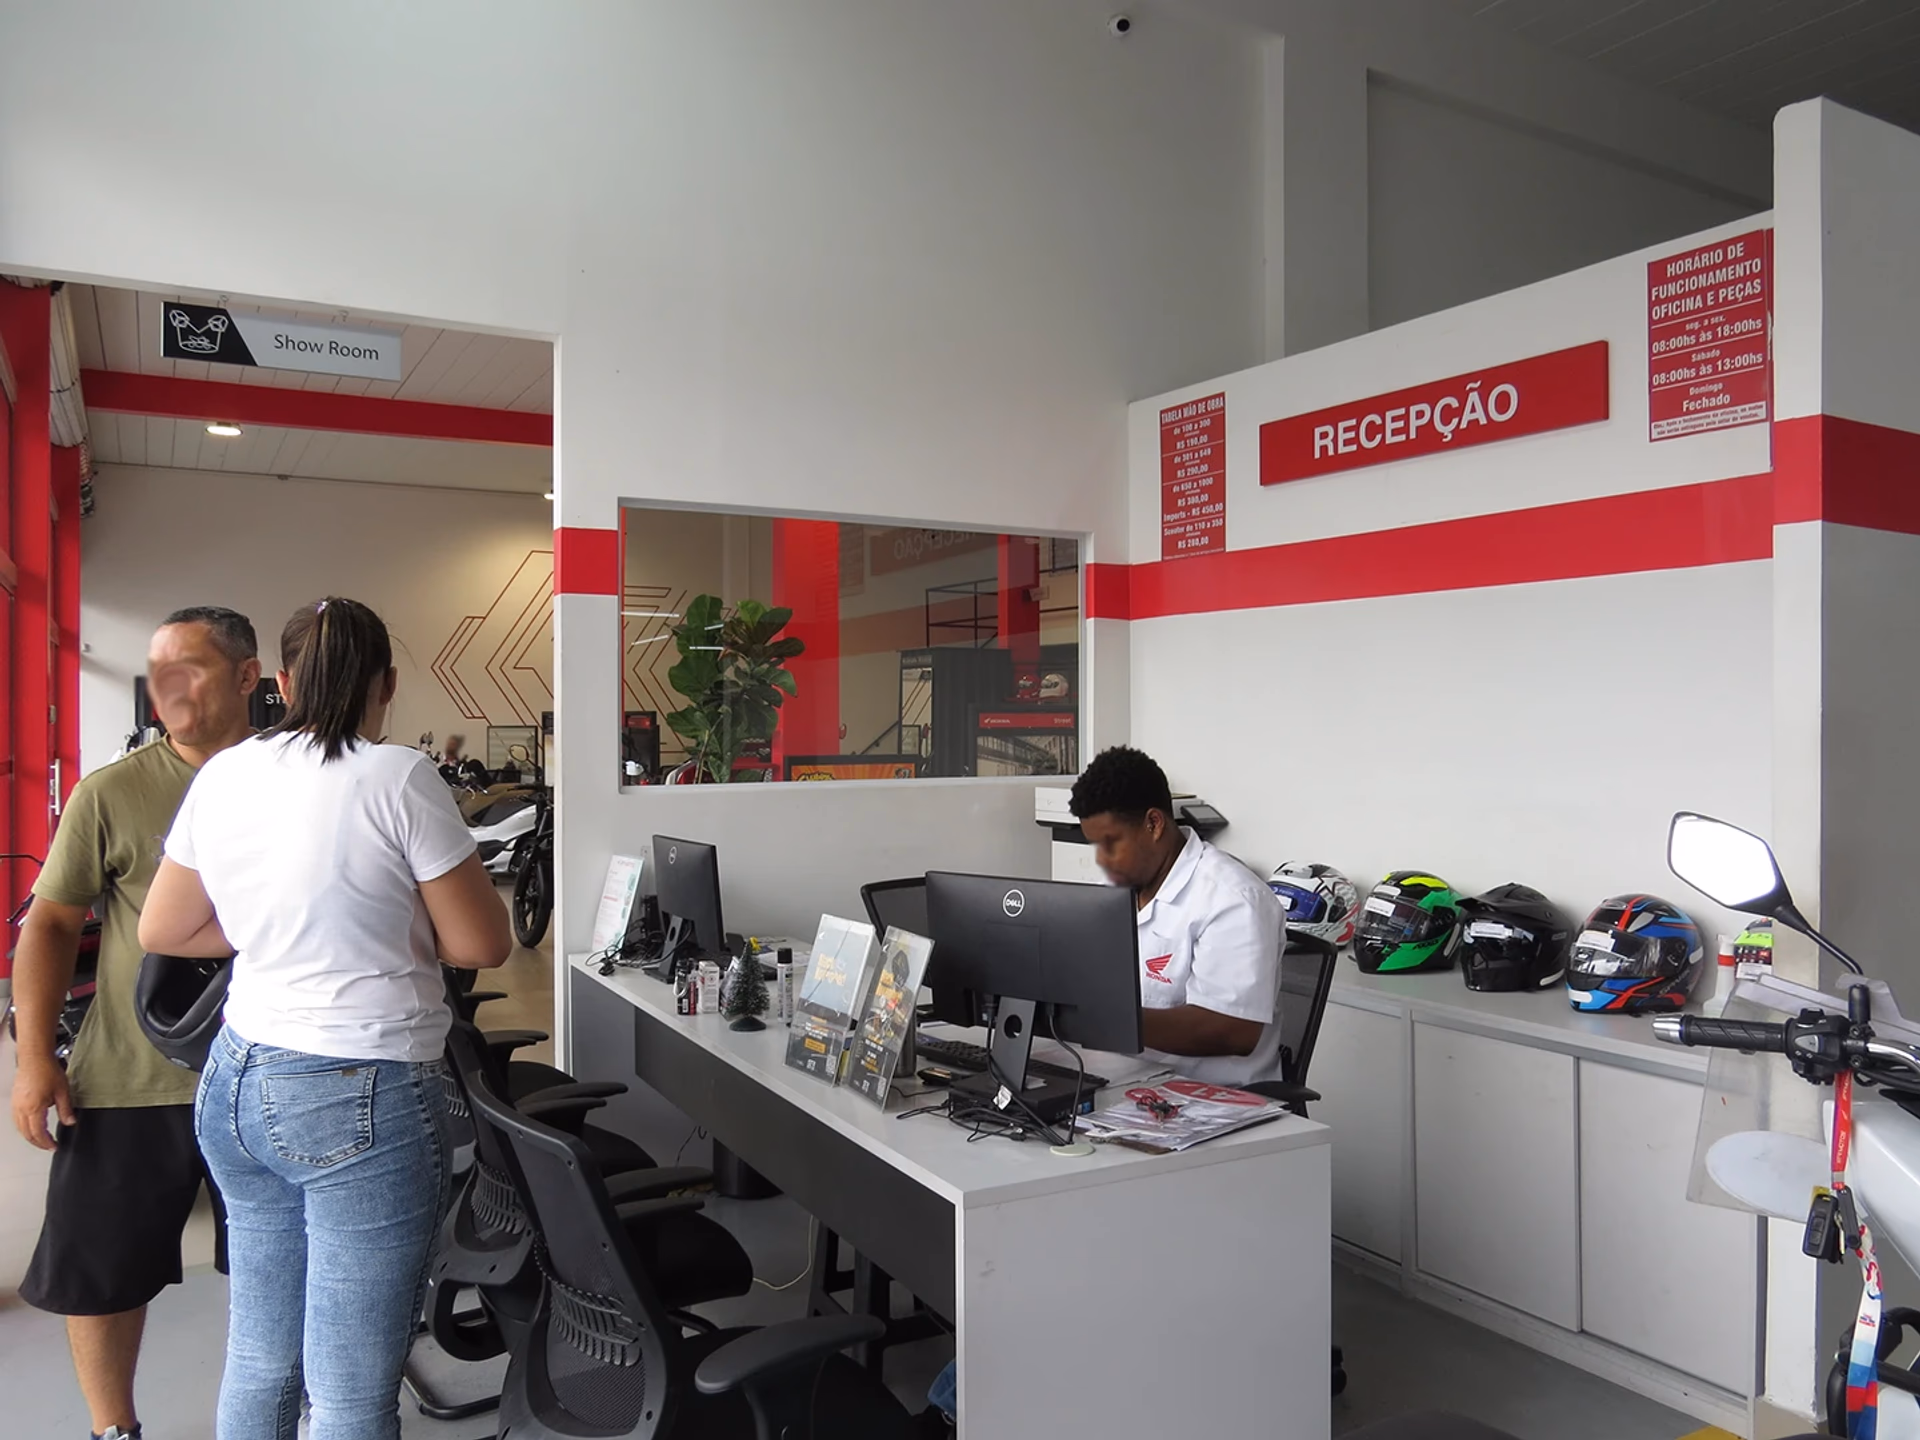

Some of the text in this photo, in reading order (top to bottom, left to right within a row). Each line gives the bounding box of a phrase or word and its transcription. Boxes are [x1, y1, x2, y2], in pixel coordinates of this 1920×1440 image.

[1667, 242, 1744, 277] HORÁRIO DE
[1652, 258, 1761, 300] FUNCIONAMENTO
[1652, 279, 1761, 320] OFICINA E PEÇAS
[1711, 315, 1726, 324] sex.
[1653, 317, 1762, 353] 08:00hs às 18:00hs
[274, 334, 379, 360] Show Room
[1691, 349, 1720, 362] Sábado
[1653, 352, 1763, 386] 08:00hs às 13:00hs
[1689, 381, 1723, 396] Domingo
[1198, 402, 1206, 413] DE
[1207, 397, 1224, 411] OBRA
[1683, 393, 1730, 412] Fechado
[1314, 381, 1519, 458] RECEPÇÃO
[1173, 427, 1181, 436] de
[1173, 456, 1181, 464] de
[1173, 484, 1180, 493] de
[265, 693, 285, 704] ST
[1006, 898, 1021, 908] DELL
[1146, 970, 1172, 984] HONDA
